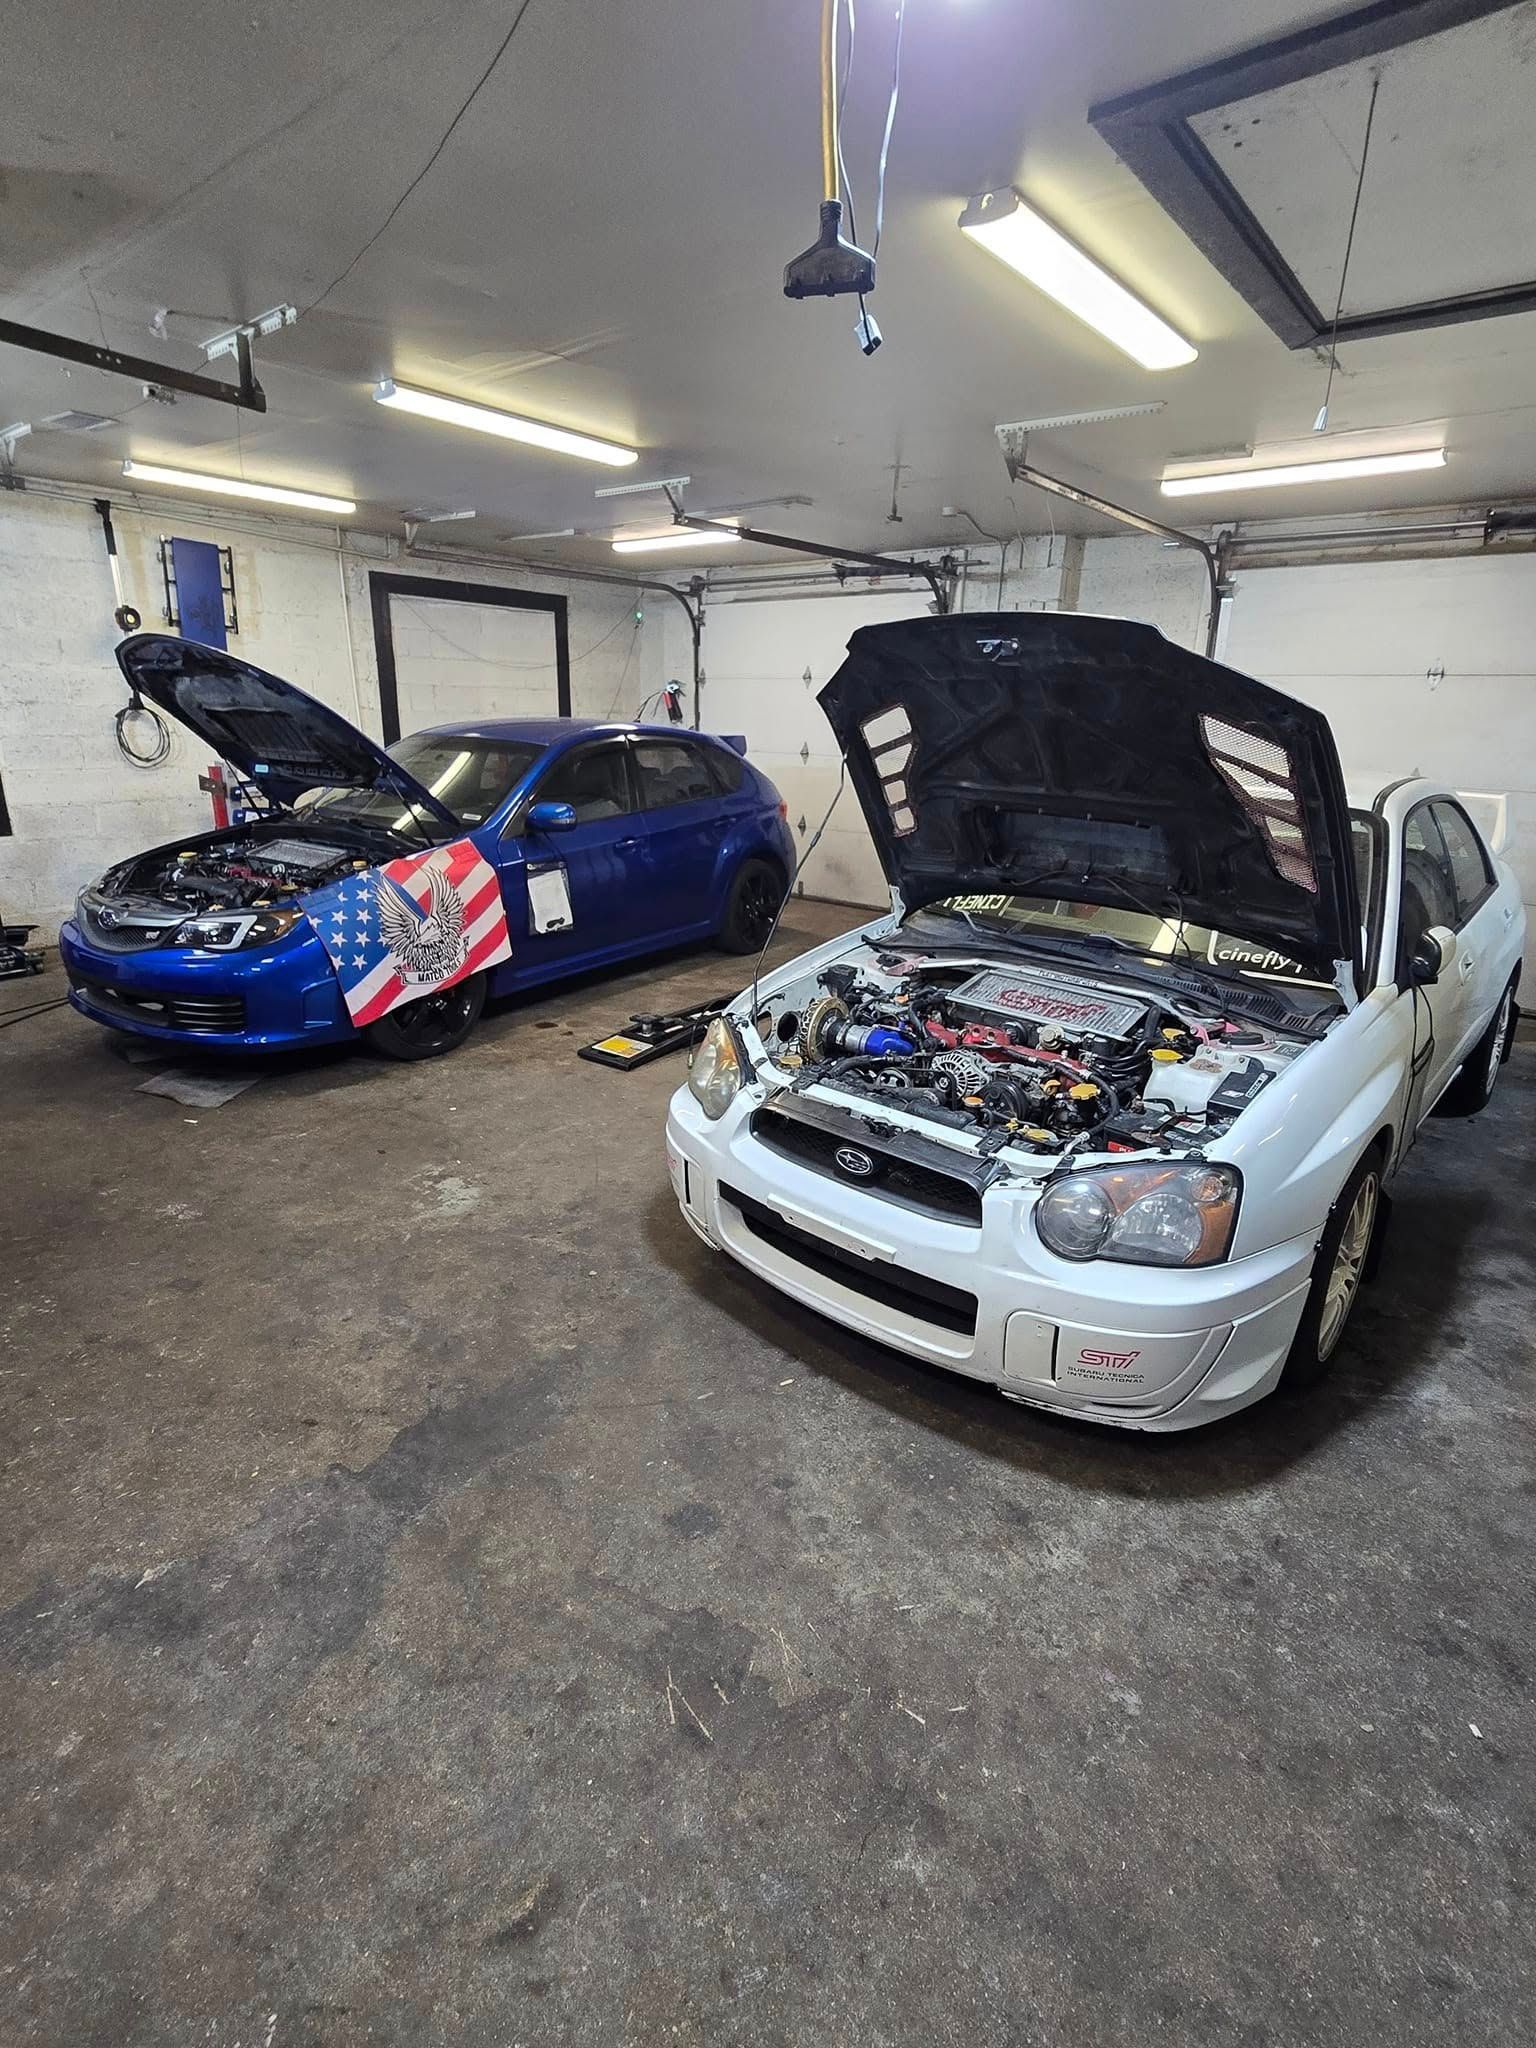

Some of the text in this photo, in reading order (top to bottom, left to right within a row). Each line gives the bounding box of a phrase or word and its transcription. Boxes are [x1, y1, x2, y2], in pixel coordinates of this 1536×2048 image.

[1218, 947, 1292, 970] cinefly
[417, 972, 444, 982] MATCO
[1067, 1366, 1105, 1376] SUBARU
[1066, 1371, 1145, 1383] INTERNATIONAL
